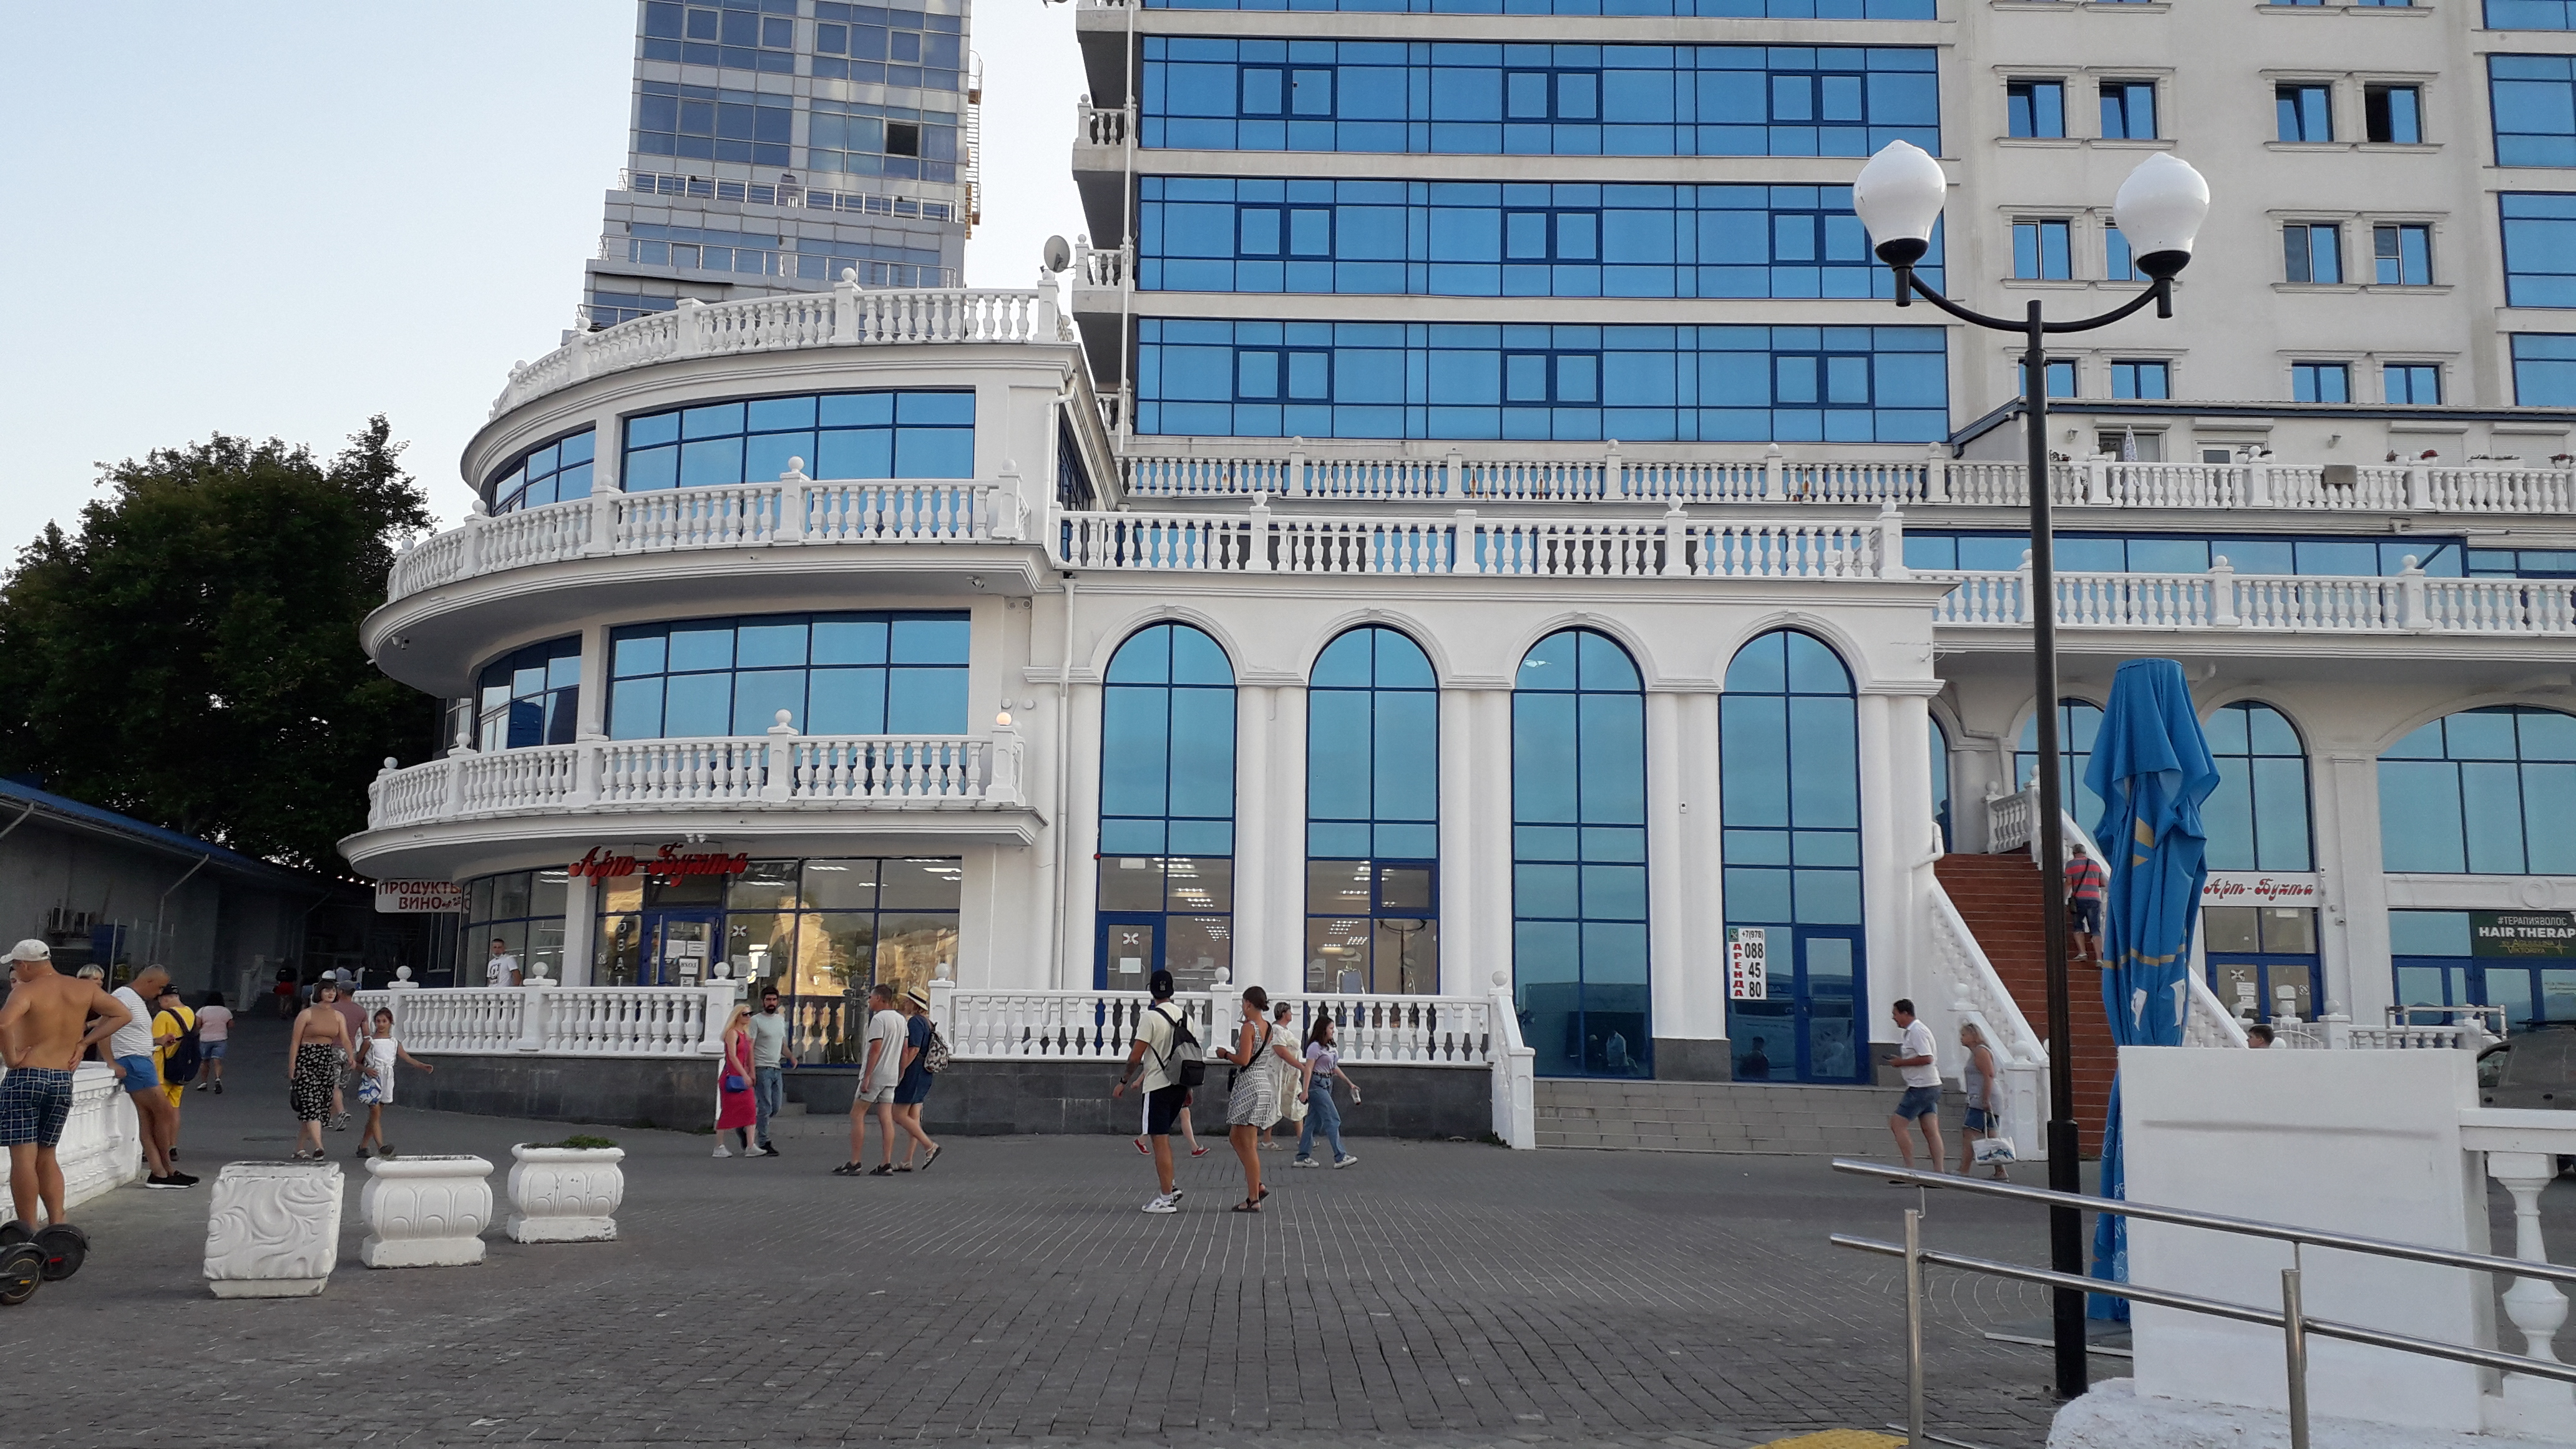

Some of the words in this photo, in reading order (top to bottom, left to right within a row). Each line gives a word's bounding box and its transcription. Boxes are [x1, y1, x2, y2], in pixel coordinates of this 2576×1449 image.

[399, 897, 442, 910] ВИНО
[1742, 930, 1764, 940] +7(978)
[2479, 927, 2515, 937] HAIR
[1745, 942, 1764, 959] 088
[1733, 943, 1745, 997] АРЕНДА
[1749, 962, 1762, 978] 45
[1749, 980, 1762, 998] 80
